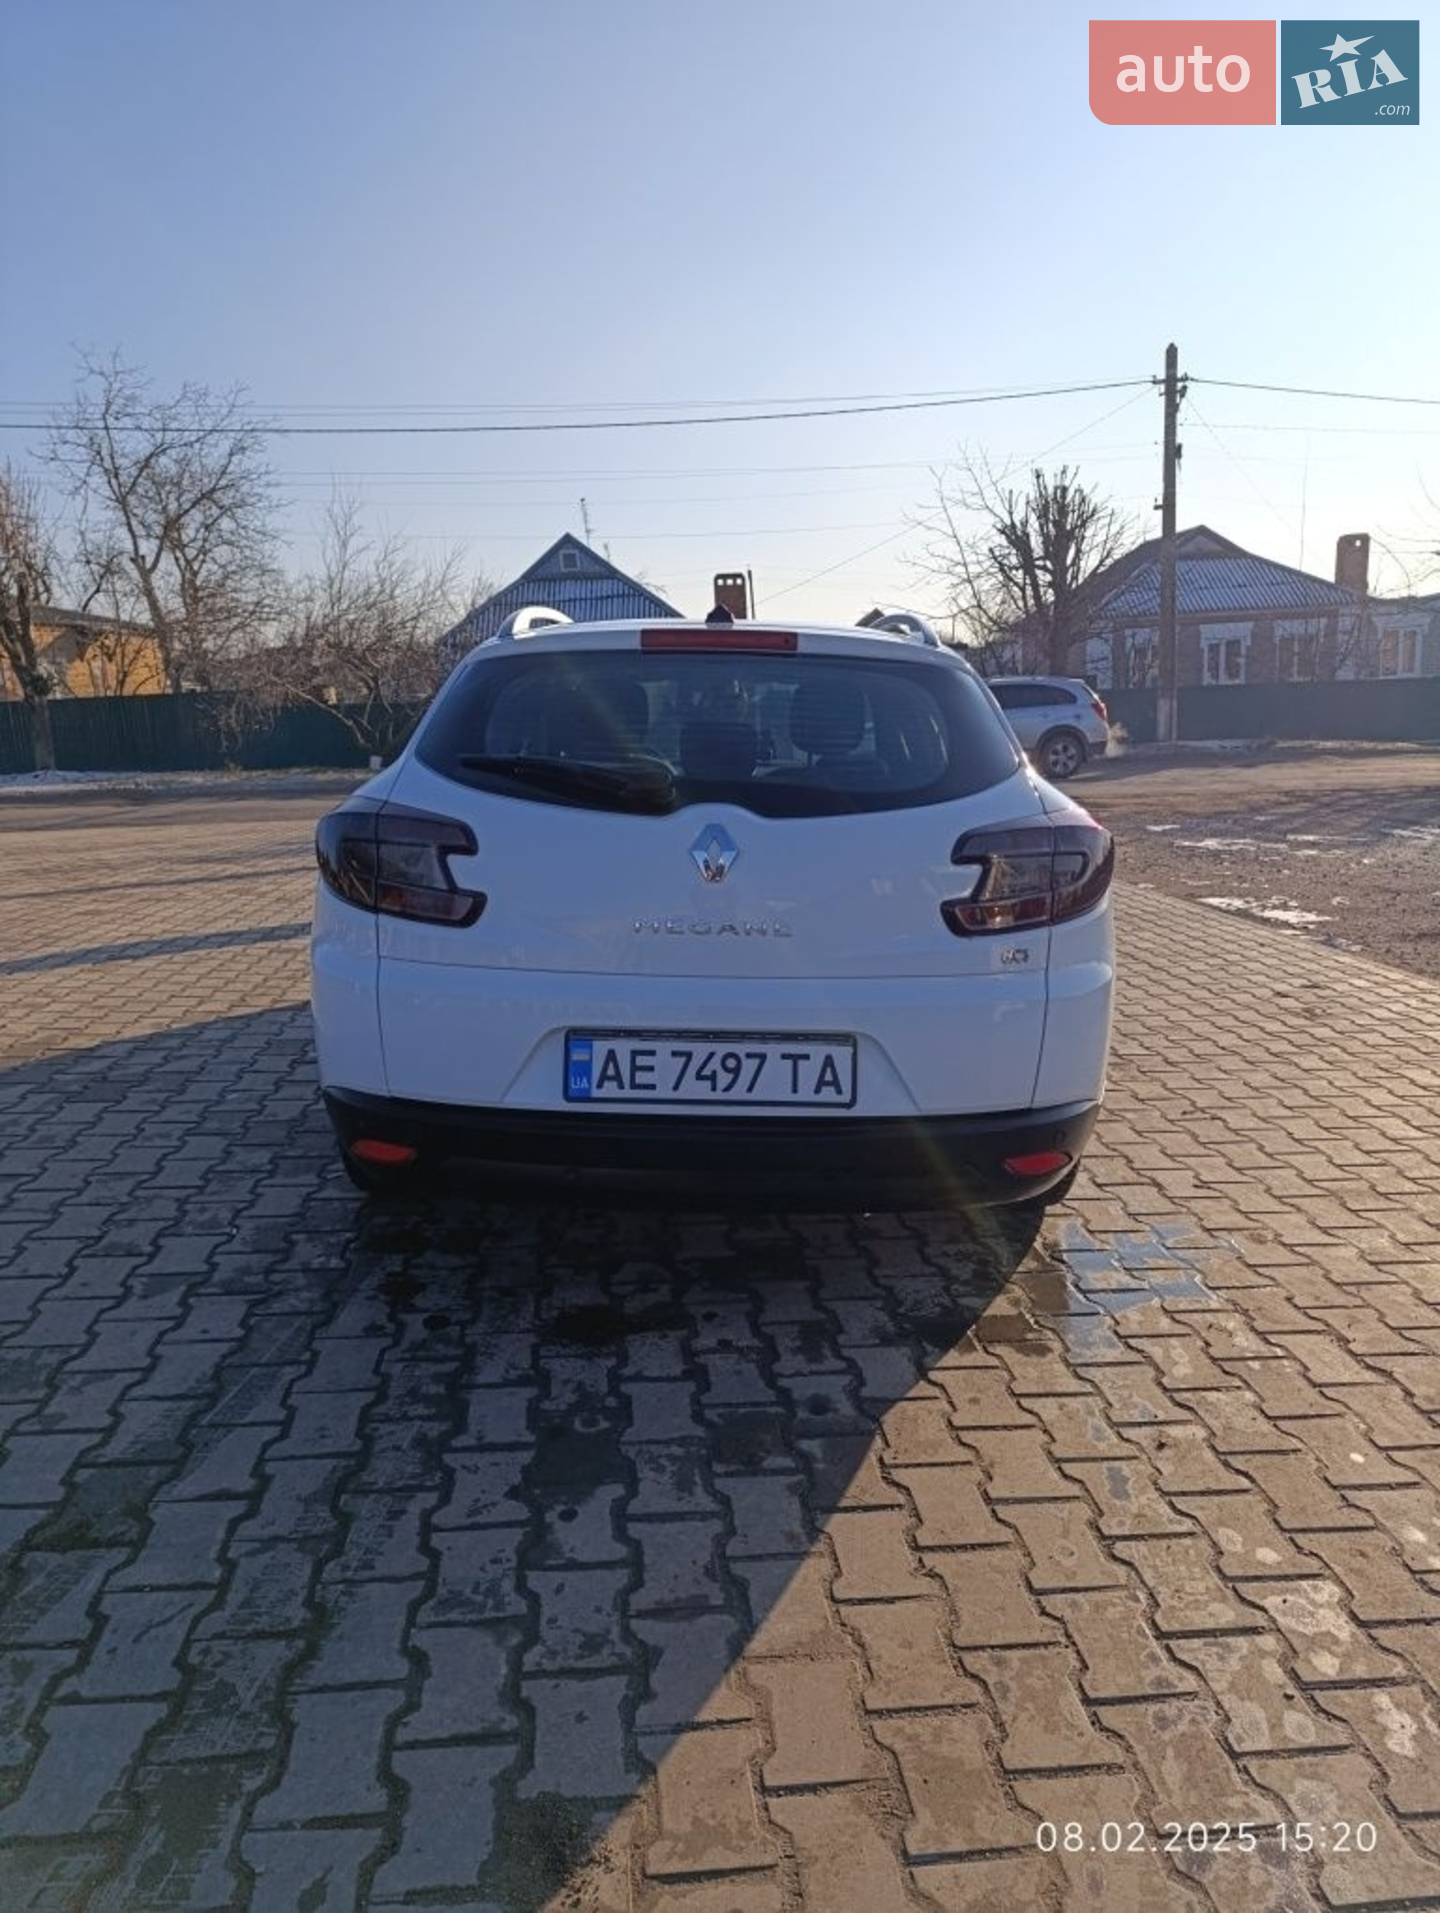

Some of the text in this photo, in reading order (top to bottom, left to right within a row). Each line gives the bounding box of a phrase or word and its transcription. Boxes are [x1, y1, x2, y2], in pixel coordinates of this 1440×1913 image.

[571, 1076, 590, 1089] UA
[595, 1048, 844, 1096] AE 7497 TA
